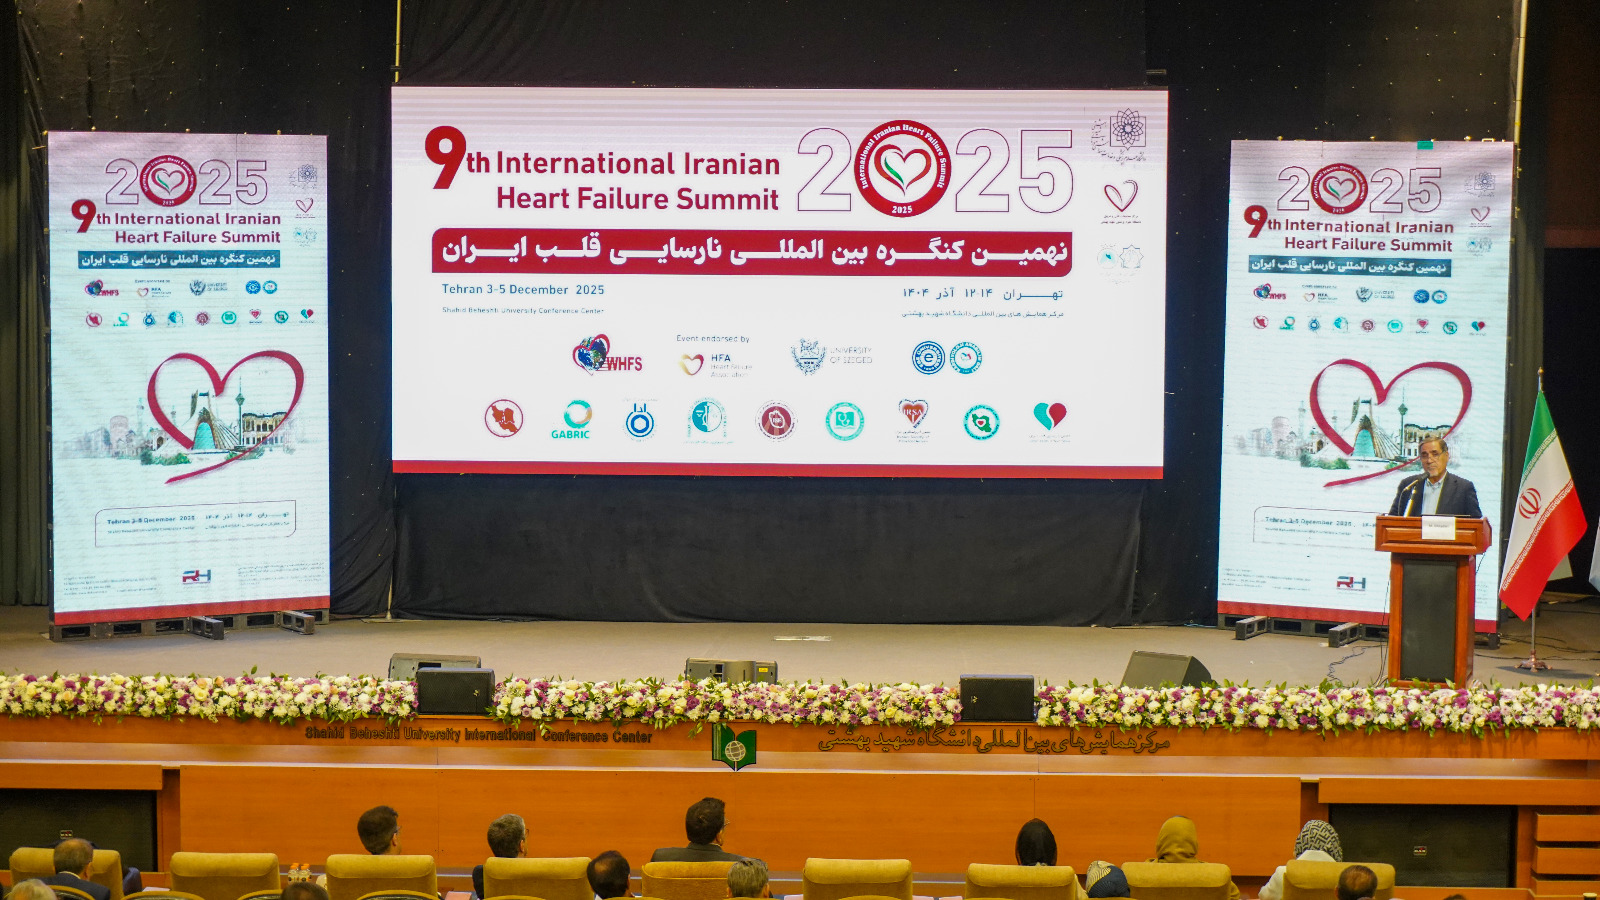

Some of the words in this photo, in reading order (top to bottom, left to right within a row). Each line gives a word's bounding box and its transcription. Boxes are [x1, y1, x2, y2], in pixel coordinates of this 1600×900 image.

[873, 125, 901, 140] Iranian
[902, 124, 924, 136] Heart
[924, 132, 944, 157] Failure
[425, 125, 490, 190] 9th
[497, 150, 674, 175] International
[685, 151, 780, 175] Iranian
[497, 186, 569, 209] Heart
[578, 187, 668, 210] Failure
[677, 187, 779, 211] Summit
[891, 205, 913, 214] 2025
[115, 212, 220, 225] International
[225, 212, 281, 225] Iranian
[1285, 218, 1390, 233] International
[1396, 221, 1455, 234] Iranian
[115, 231, 160, 244] Heart
[163, 231, 217, 243] Failure
[221, 230, 281, 243] Summit
[442, 235, 527, 263] ایران
[535, 231, 601, 263] قلب
[609, 236, 722, 265] نارسایی
[1284, 236, 1327, 249] Heart
[1331, 237, 1386, 251] Failure
[1390, 239, 1453, 253] Summit
[730, 238, 823, 266] المللی
[831, 243, 868, 265] بین
[876, 237, 965, 266] کنگره
[971, 240, 1068, 266] نهمین
[81, 254, 106, 266] ایران
[108, 252, 128, 265] قلب
[131, 254, 168, 266] نارسایی
[169, 253, 199, 266] المللی
[200, 256, 218, 266] بین
[219, 253, 245, 266] کنگره
[246, 255, 276, 265] نهمین
[1251, 258, 1275, 270] ایران
[1277, 257, 1298, 269] قلب
[1300, 260, 1336, 272] نارسایی
[1337, 261, 1367, 273] المللی
[1368, 263, 1385, 273] بین
[1388, 260, 1415, 273] کنگره
[1415, 264, 1447, 274] نهمین
[442, 284, 483, 294] Tehran
[486, 284, 506, 294] 3-5
[509, 284, 569, 295] December
[576, 285, 605, 295] 2025
[903, 288, 929, 297] ۱۴۰۴
[936, 286, 955, 300] آذر
[1003, 288, 1063, 300] تهران
[740, 335, 750, 343] by
[606, 356, 643, 371] WHFS
[711, 354, 731, 362] HFA
[551, 430, 590, 439] GABRIC
[305, 726, 345, 739] Shahid
[350, 726, 400, 740] Beheshti
[403, 727, 461, 742] University
[464, 728, 536, 741] International
[541, 728, 608, 743] Conference
[612, 730, 653, 744] Center
